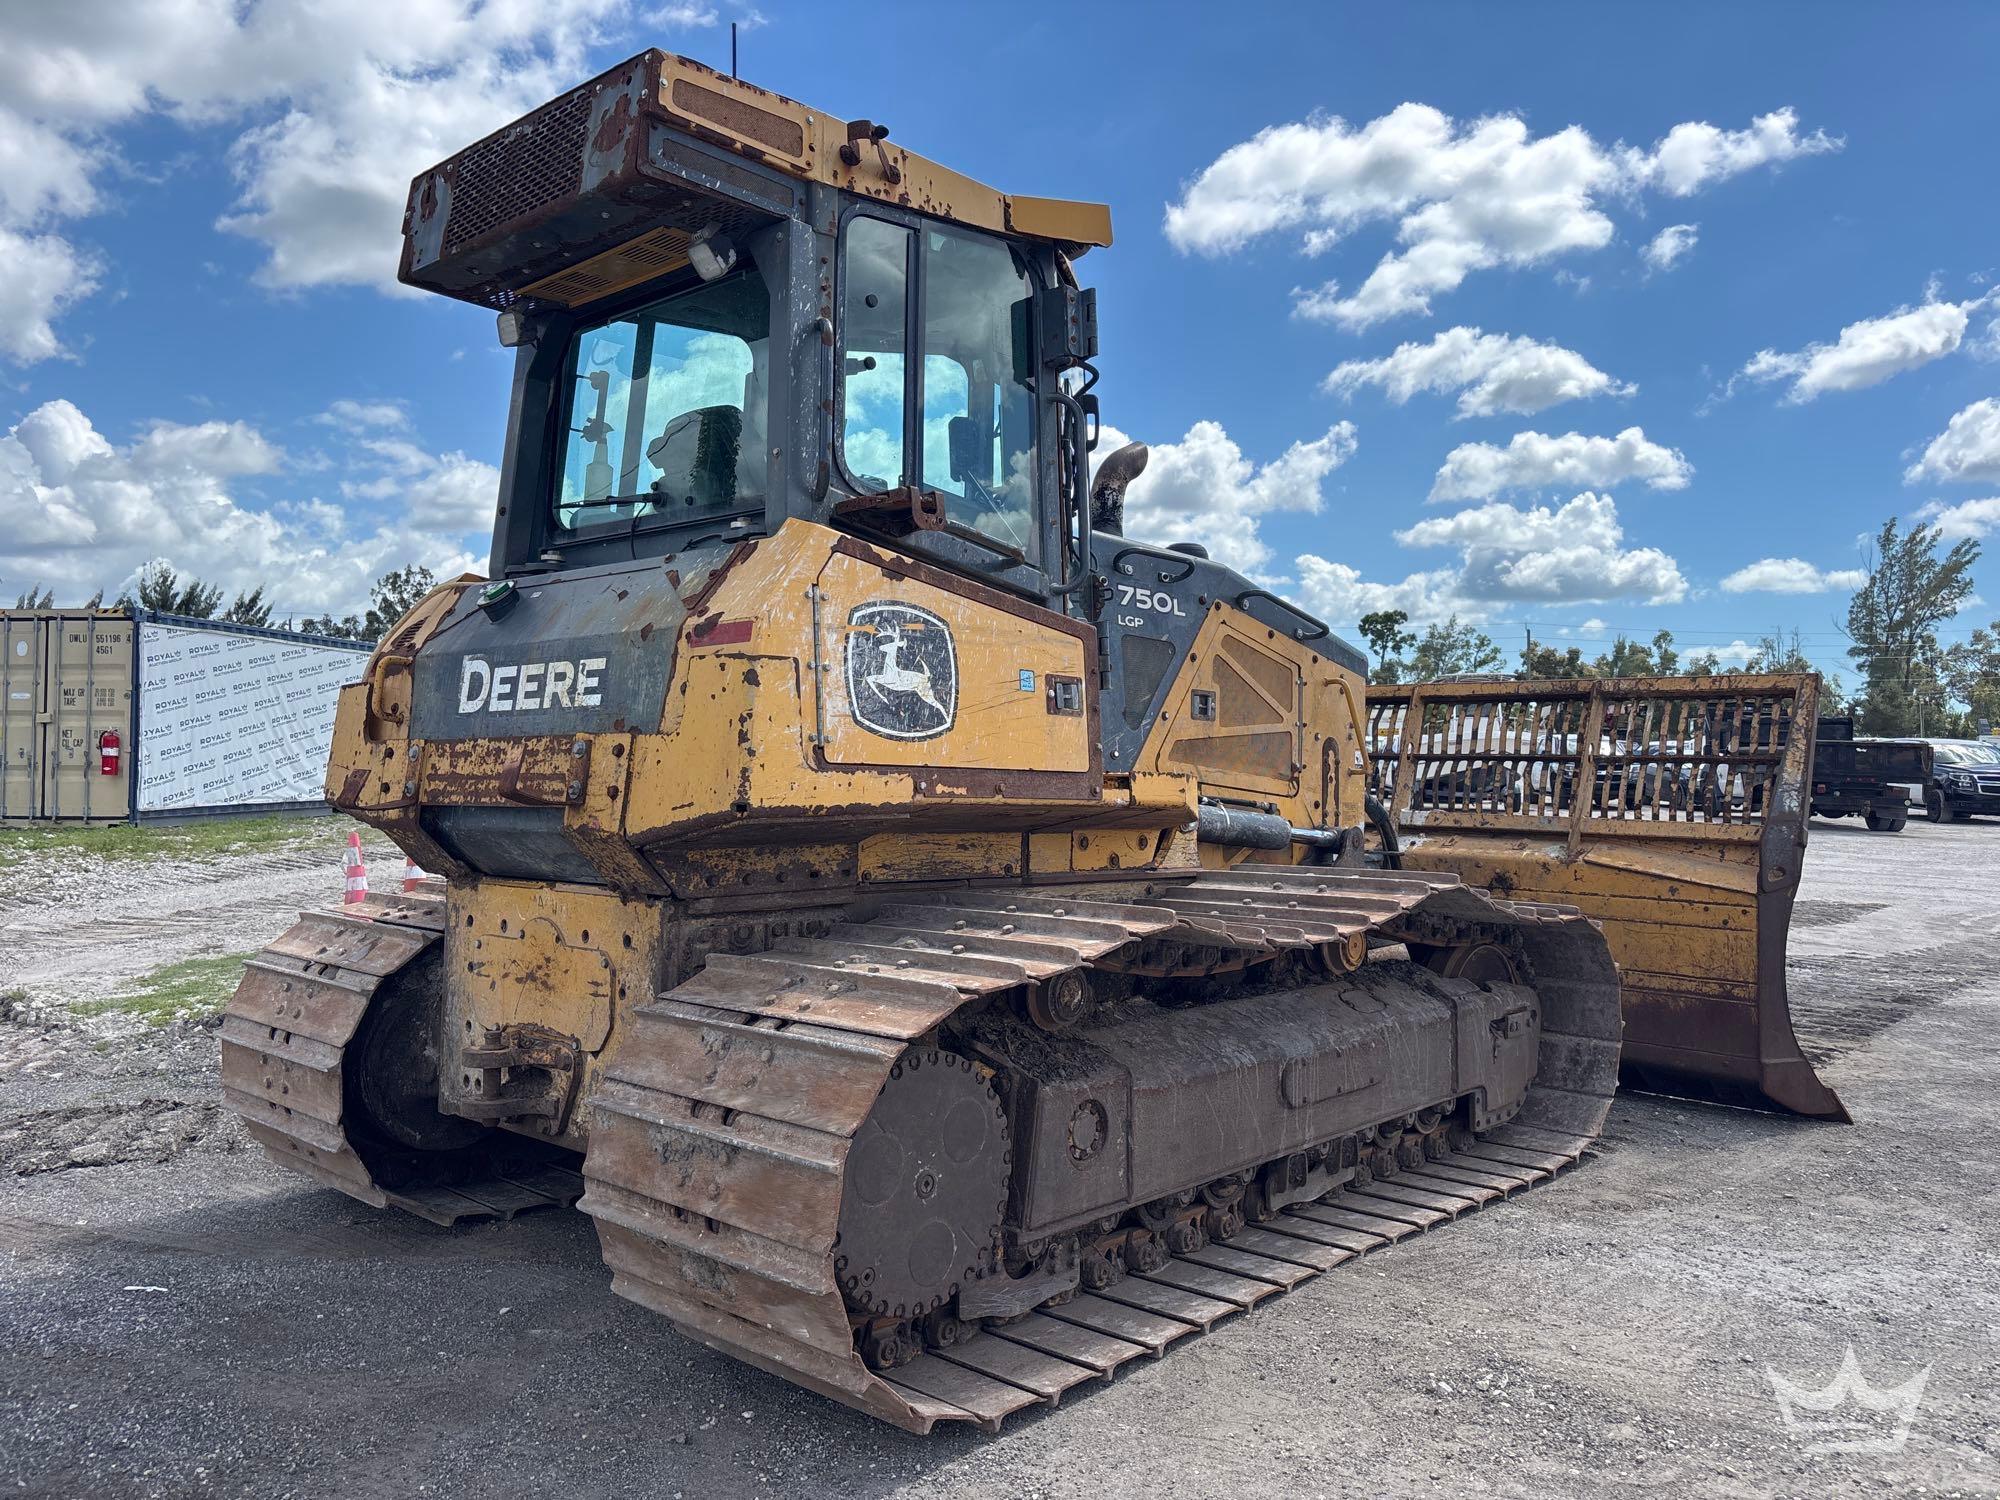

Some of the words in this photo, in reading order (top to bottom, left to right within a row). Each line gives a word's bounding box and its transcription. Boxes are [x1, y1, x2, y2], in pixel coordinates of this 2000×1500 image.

[1117, 584, 1186, 617] 750L
[1117, 614, 1144, 628] LGP
[96, 634, 121, 643] 551196
[227, 638, 249, 647] ROYAL
[96, 645, 113, 655] 45G1
[189, 645, 214, 654] ROYAL
[282, 649, 302, 658] ROYAL
[148, 652, 175, 662] ROYAL
[249, 656, 271, 665] ROYAL
[213, 663, 237, 673] ROYAL
[329, 659, 346, 667] ROYAL
[299, 666, 318, 675] ROYAL
[174, 671, 200, 681] ROYAL
[267, 673, 288, 682] ROYAL
[345, 674, 362, 682] ROYA
[233, 681, 256, 691] ROYAL
[317, 682, 336, 691] ROYAL
[458, 654, 607, 714] DEERE
[195, 690, 220, 700] ROYAL
[287, 690, 306, 699] ROYAL
[155, 699, 182, 710] ROYAL
[254, 697, 276, 707] ROYAL
[219, 707, 242, 717] ROYAL
[303, 705, 322, 715] ROYAL
[180, 716, 205, 727] ROYAL
[272, 714, 292, 724] ROYAL
[239, 723, 261, 734] ROYAL
[320, 721, 335, 730] ROYA
[144, 726, 165, 737] OYAL
[290, 729, 310, 739] ROYAL
[201, 733, 225, 745] ROYAL
[258, 739, 279, 750] ROYAL
[160, 744, 187, 756] ROYAL
[224, 749, 247, 761] ROYAL
[306, 745, 325, 755] ROYAL
[275, 755, 295, 765] ROYAL
[184, 761, 208, 773] ROYAL
[242, 765, 264, 777] ROYAL
[294, 769, 313, 779] ROYAL
[204, 777, 228, 789] ROYAL
[261, 780, 282, 791] ROYAL
[309, 784, 325, 794] ROYA
[163, 790, 189, 803] ROYAL
